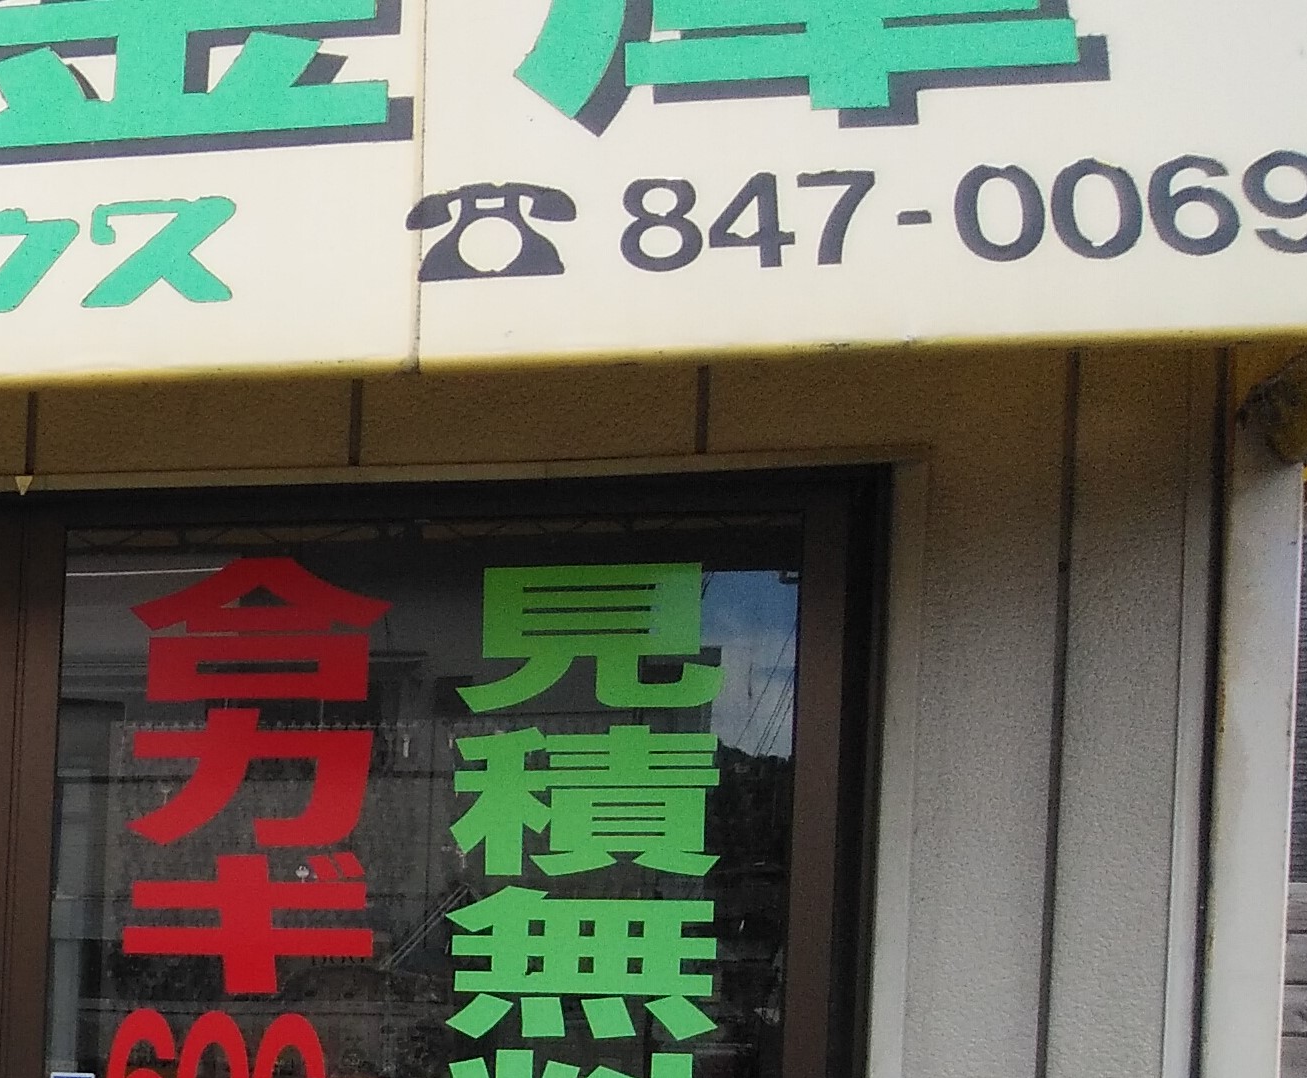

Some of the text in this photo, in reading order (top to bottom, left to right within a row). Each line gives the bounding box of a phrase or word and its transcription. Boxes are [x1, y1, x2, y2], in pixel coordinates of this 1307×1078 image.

[619, 149, 1307, 273] 847-0069
[123, 556, 392, 995] 合カギ
